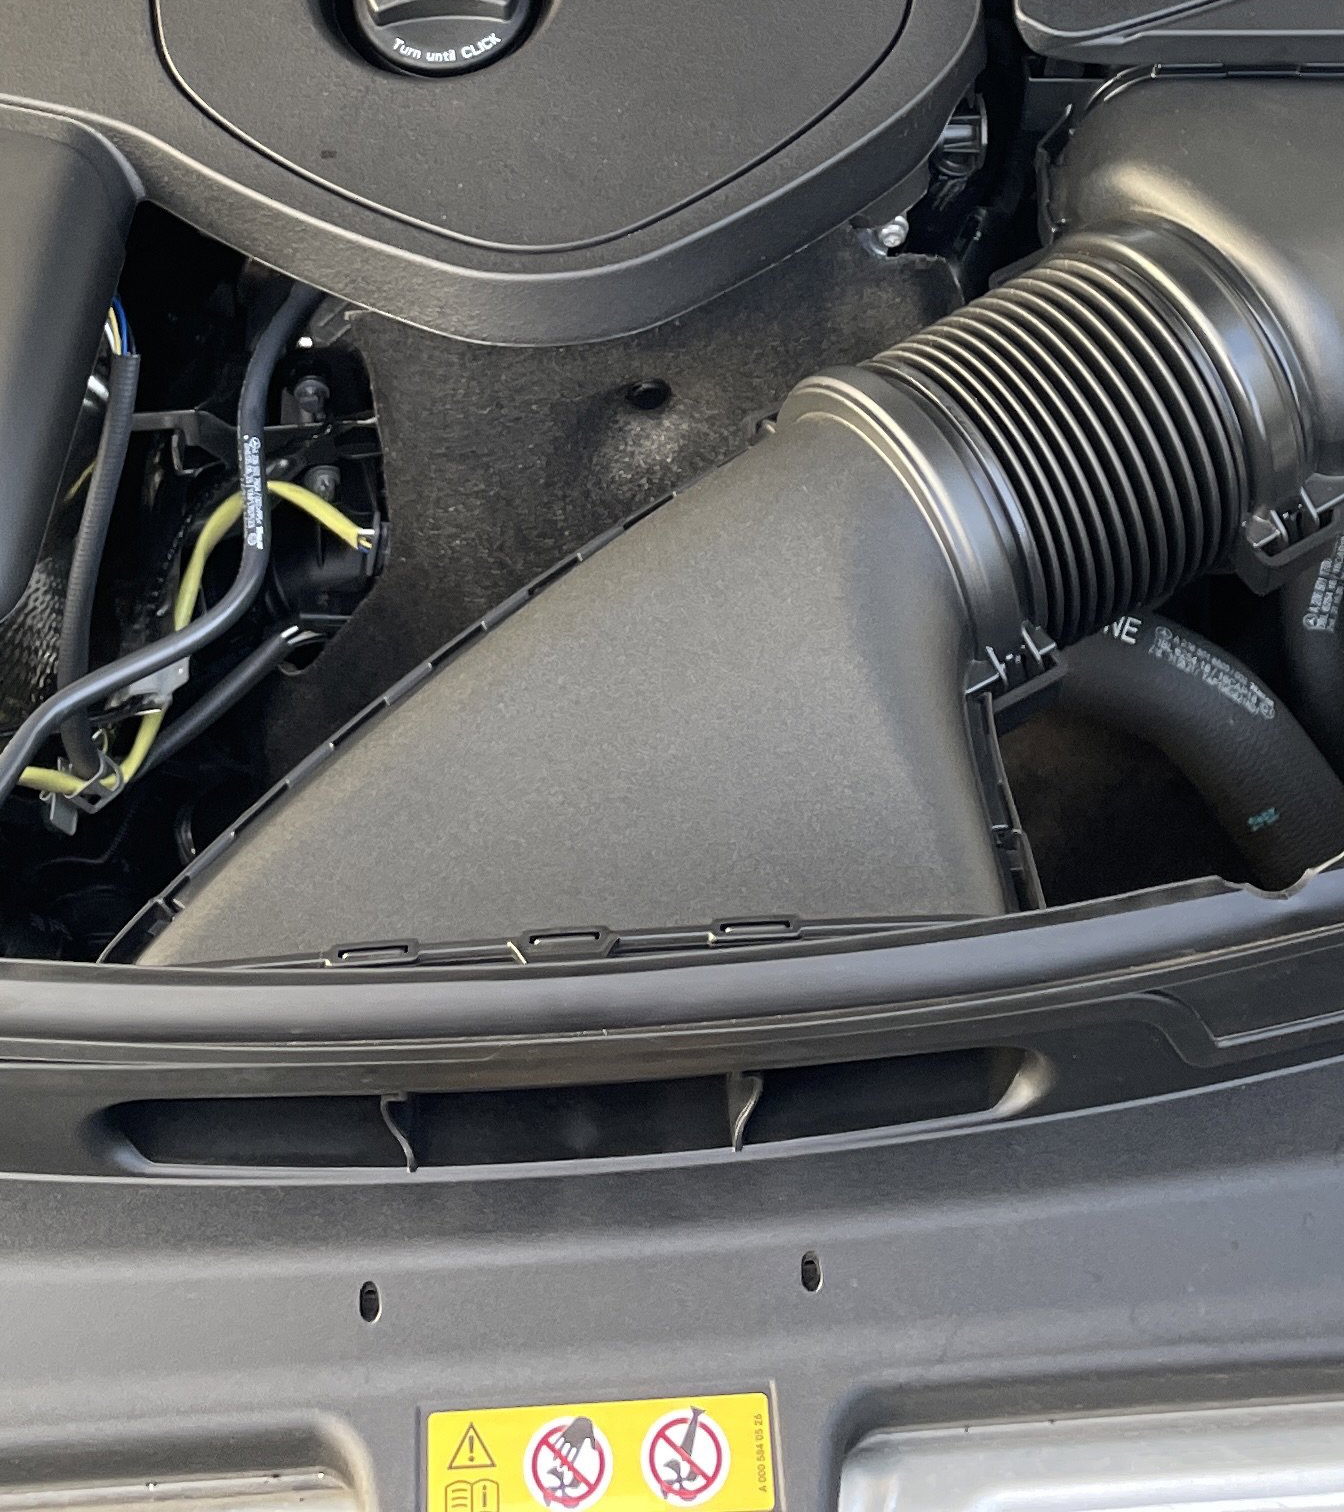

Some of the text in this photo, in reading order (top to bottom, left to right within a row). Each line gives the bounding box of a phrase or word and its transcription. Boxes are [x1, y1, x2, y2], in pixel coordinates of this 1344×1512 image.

[393, 32, 502, 62] Turn until CLICK
